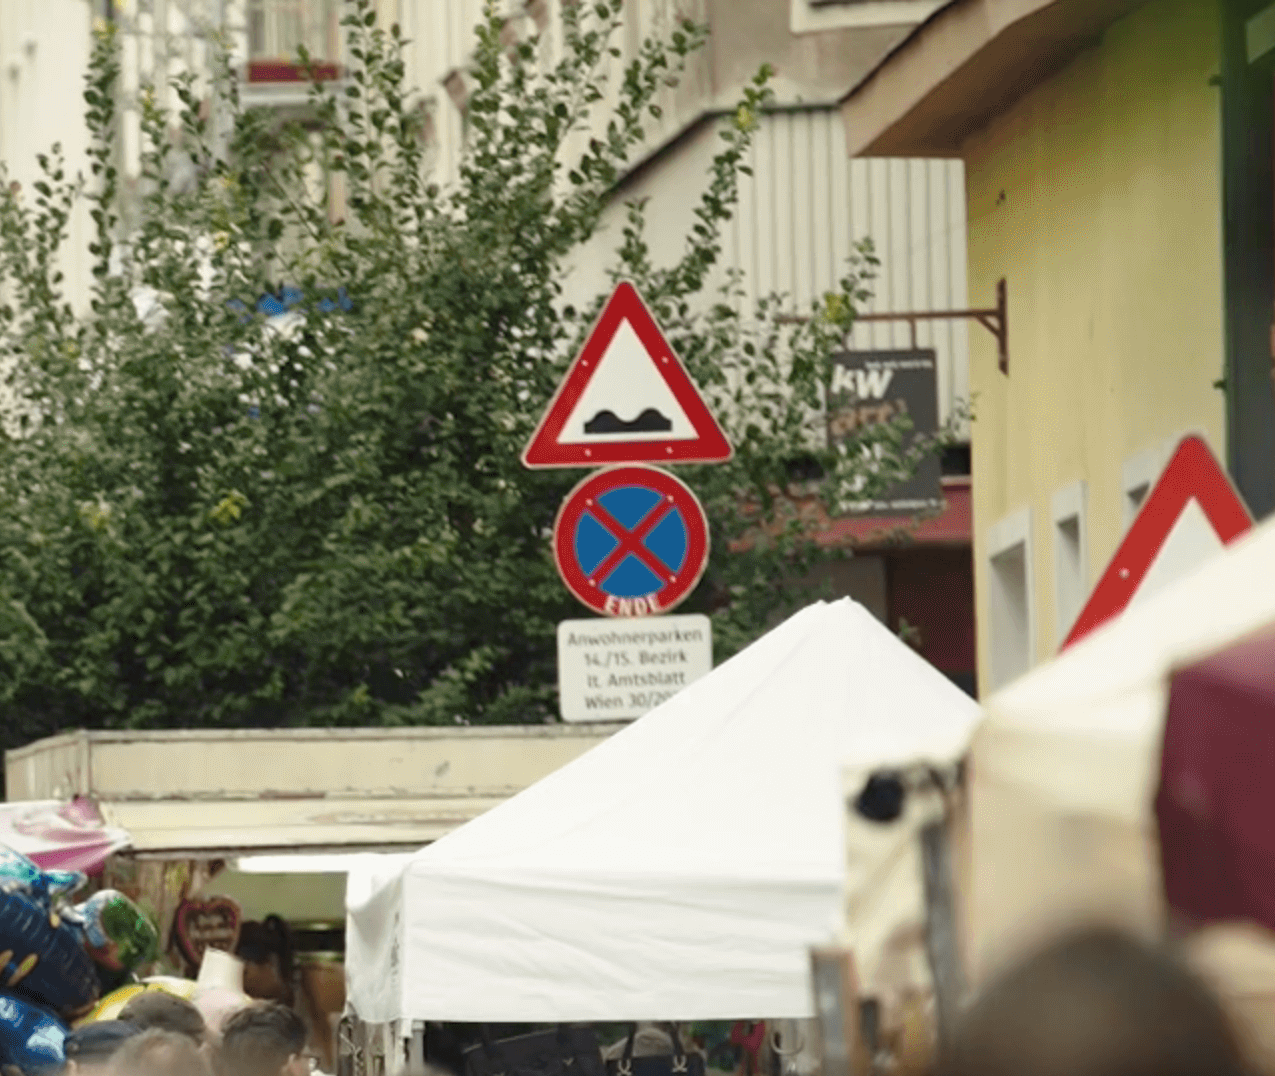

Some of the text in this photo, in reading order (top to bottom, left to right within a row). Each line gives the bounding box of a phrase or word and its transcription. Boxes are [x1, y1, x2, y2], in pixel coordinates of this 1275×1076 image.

[567, 627, 703, 647] Anwohnerparken
[638, 649, 687, 665] Bezirk
[607, 671, 686, 687] Amtsblatt
[584, 695, 624, 709] Wien
